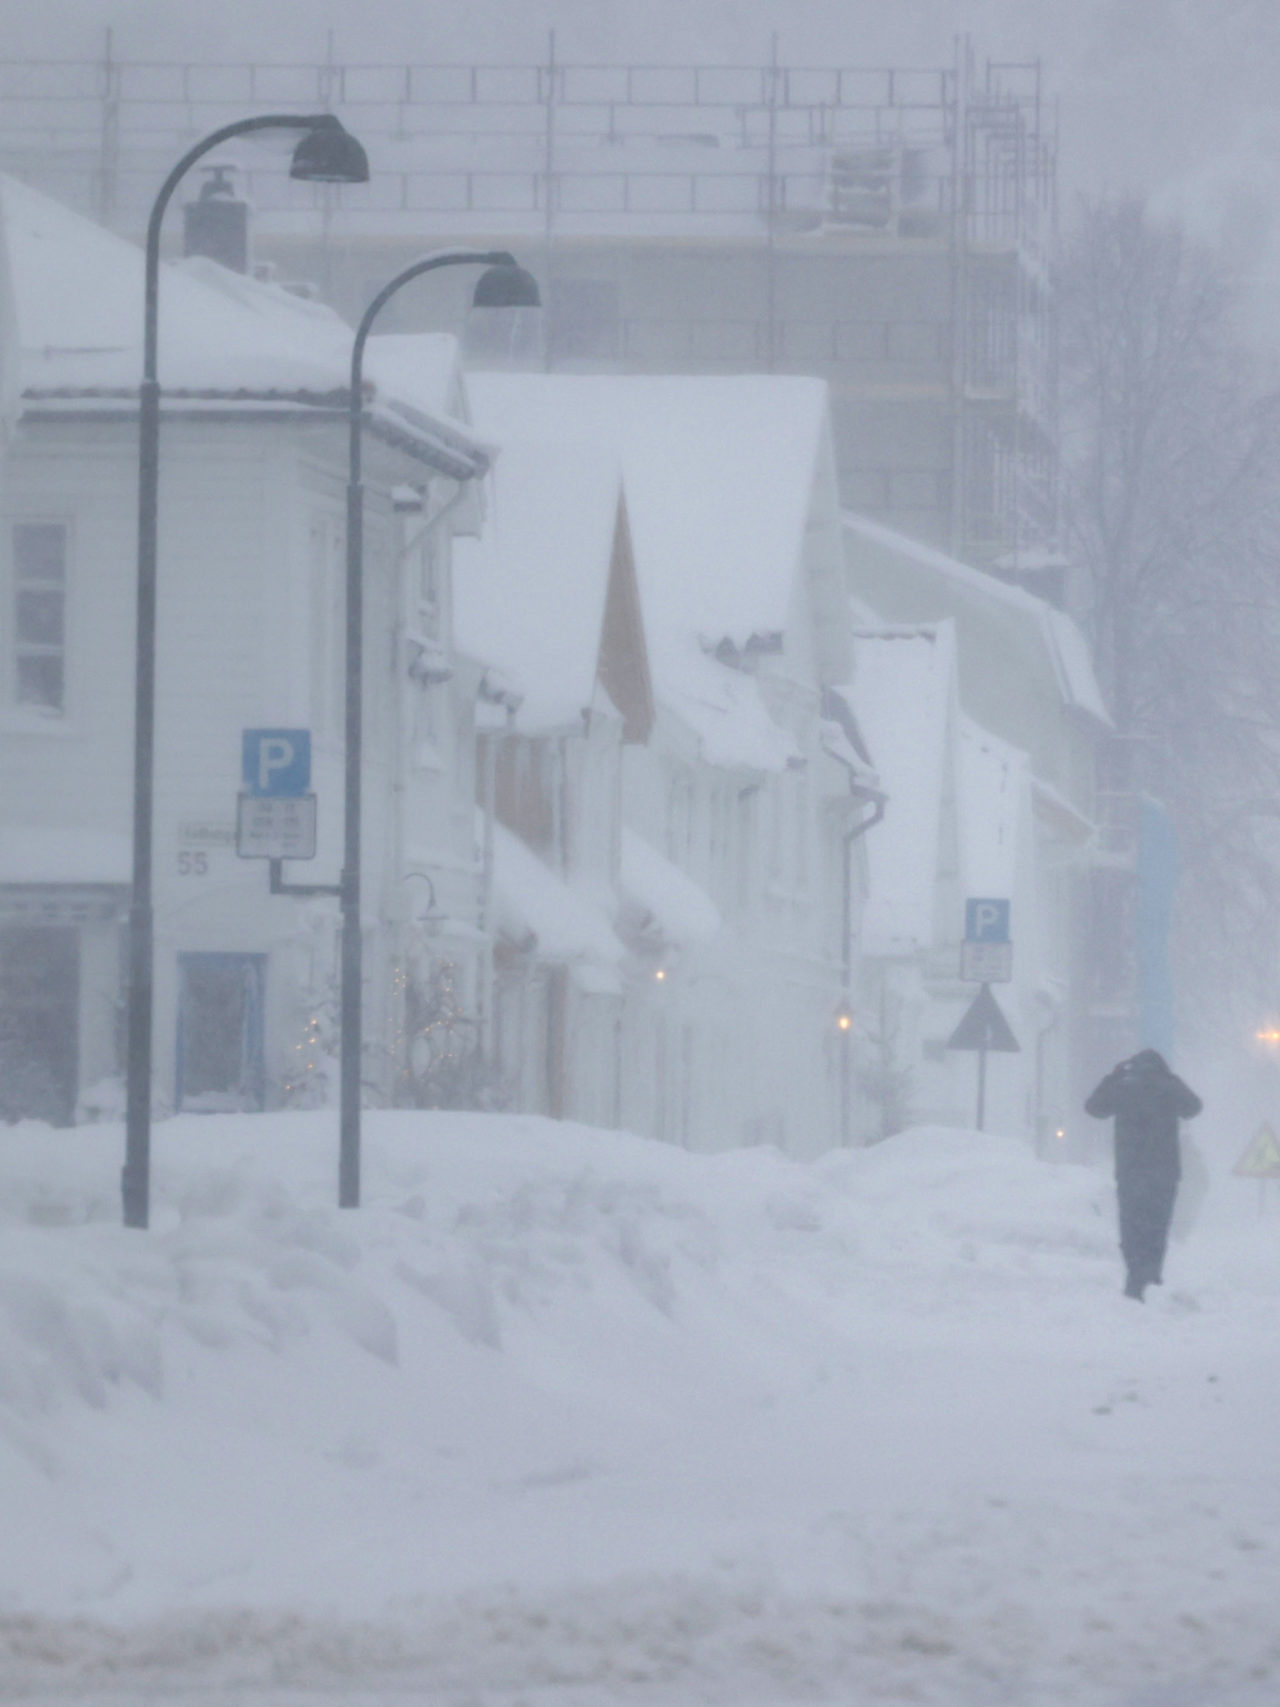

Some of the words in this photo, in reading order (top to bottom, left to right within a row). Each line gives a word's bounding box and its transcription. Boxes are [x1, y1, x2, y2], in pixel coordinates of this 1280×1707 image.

[259, 738, 295, 789] P
[177, 851, 208, 876] 55
[976, 903, 999, 937] P
